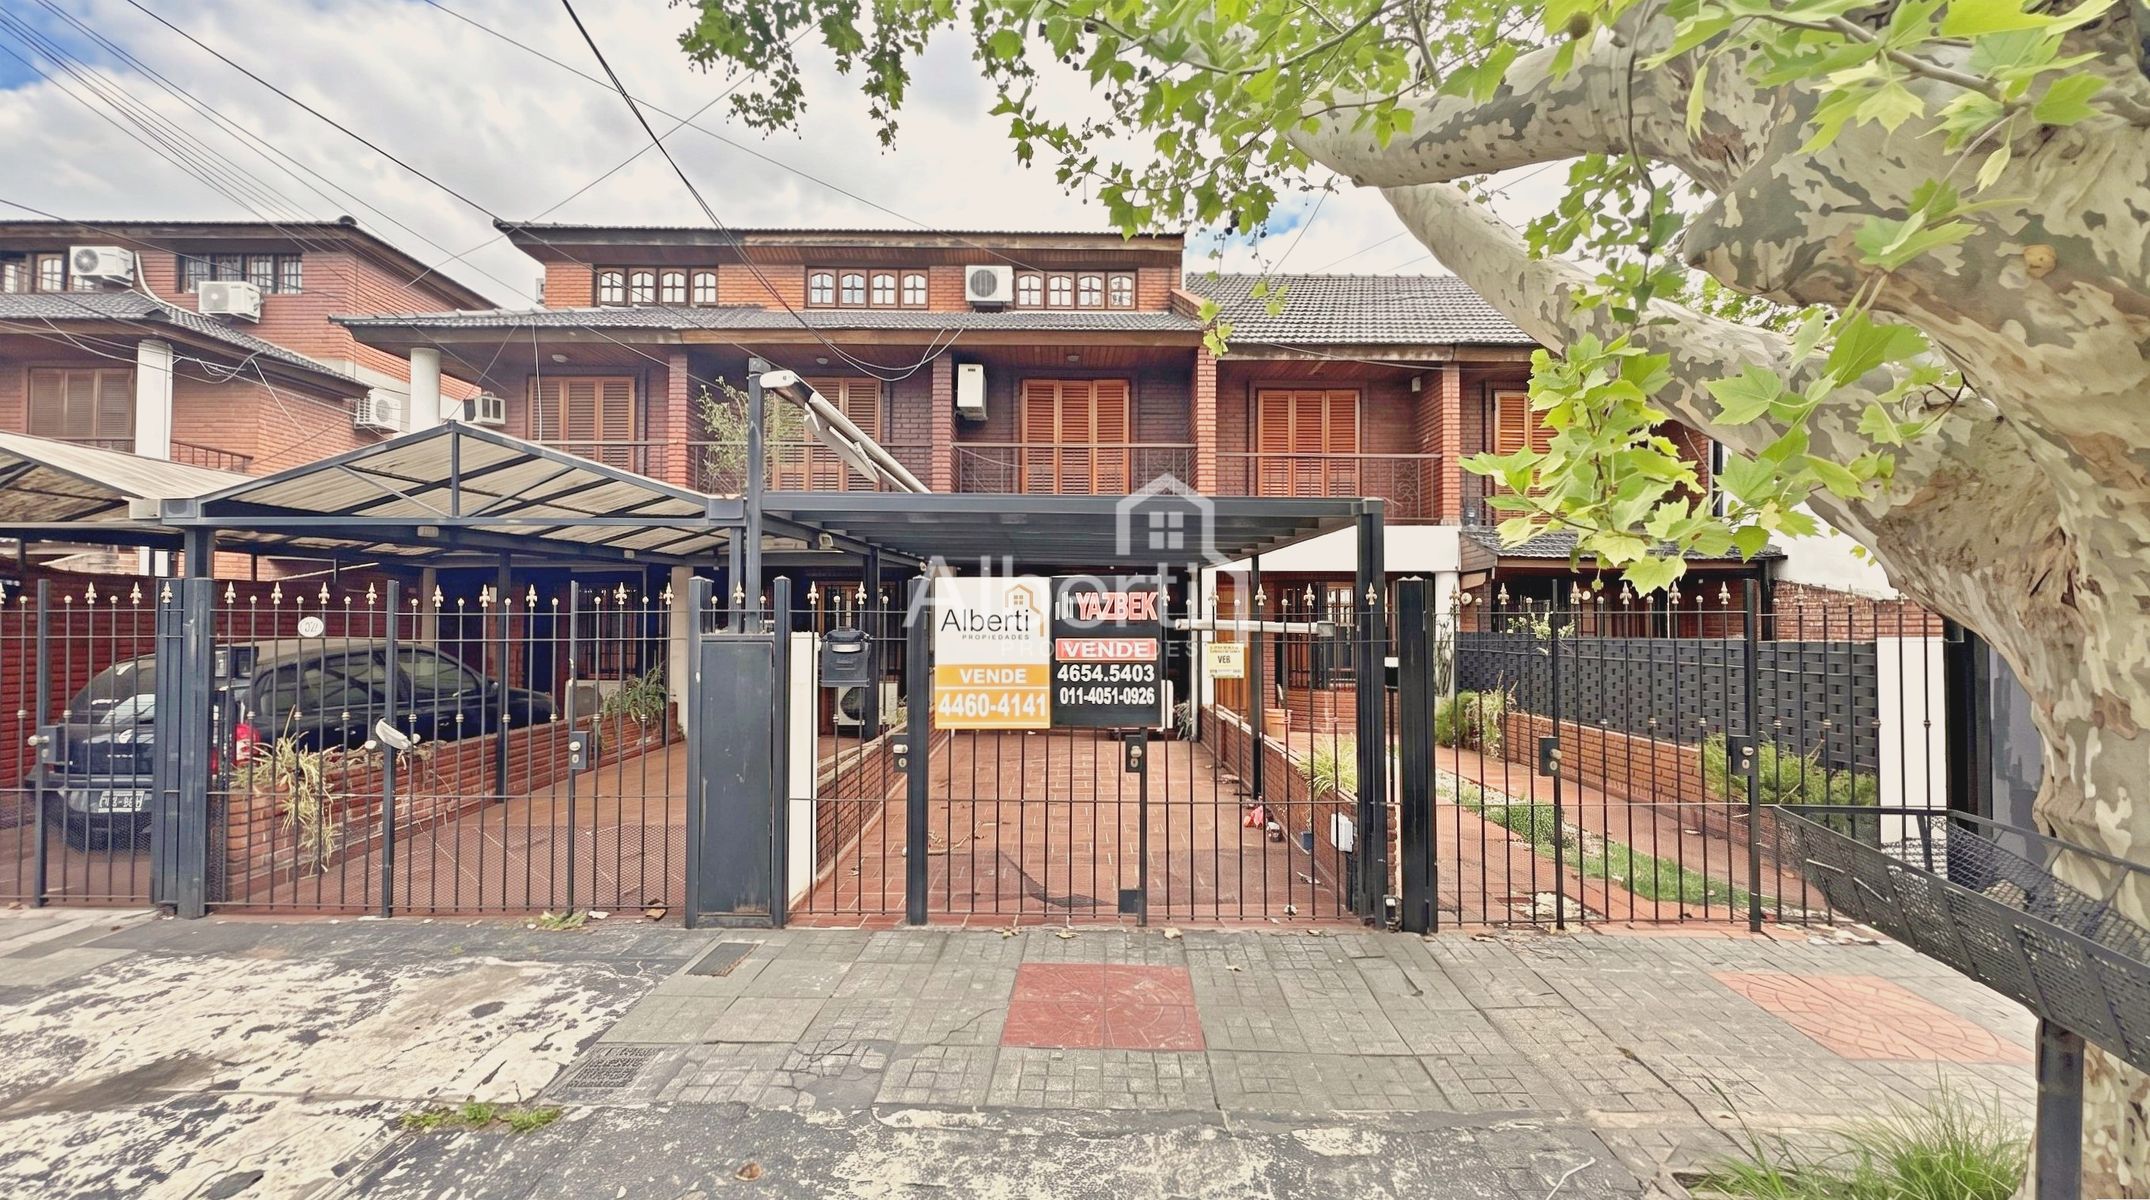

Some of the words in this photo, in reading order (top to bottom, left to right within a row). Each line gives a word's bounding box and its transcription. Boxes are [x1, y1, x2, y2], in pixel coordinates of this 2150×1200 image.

[1075, 592, 1159, 620] YAZBEK
[941, 609, 1029, 632] Alberti
[1062, 641, 1149, 658] VENDE
[959, 668, 1028, 684] VENDE
[1057, 664, 1155, 682] 4654.5403
[1059, 687, 1155, 705] 011-4051-0926
[938, 693, 1046, 718] 4460-4141
